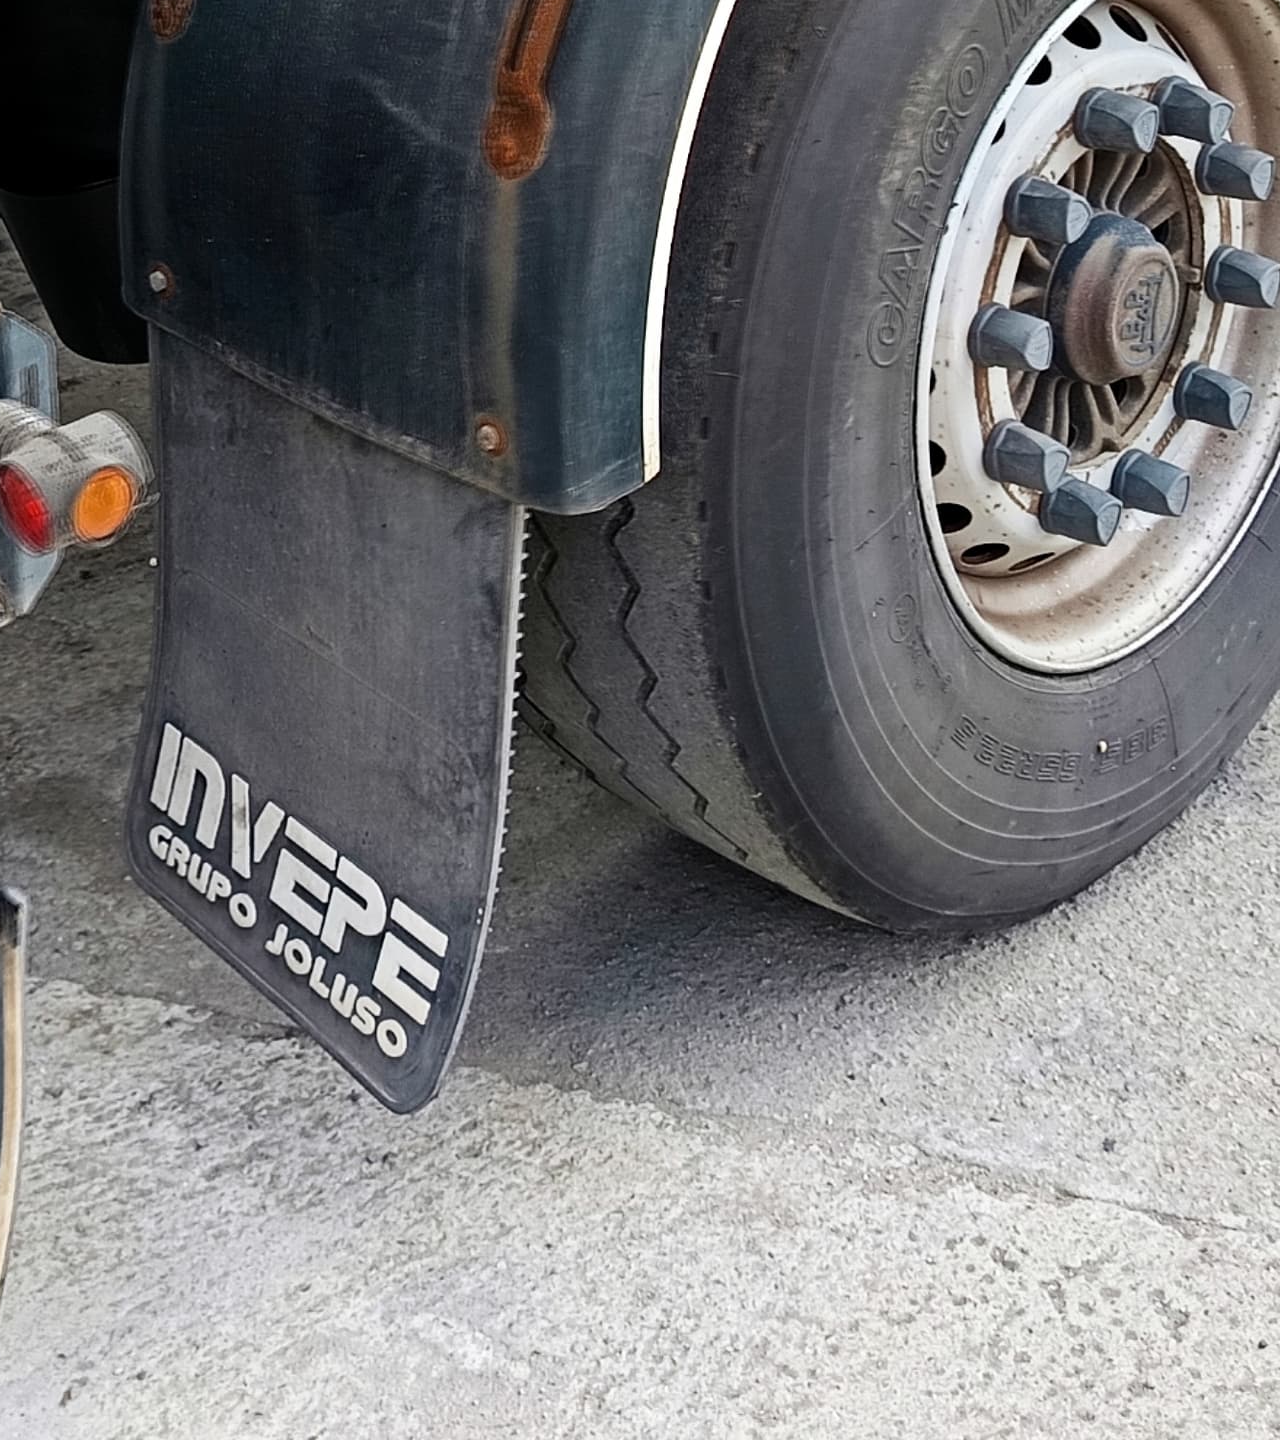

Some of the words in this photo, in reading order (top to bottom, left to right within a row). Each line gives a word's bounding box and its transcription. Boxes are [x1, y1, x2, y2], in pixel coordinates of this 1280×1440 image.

[866, 42, 989, 369] CARGO
[147, 823, 258, 930] GRUPO
[264, 922, 408, 1059] JOLUSO
[149, 721, 450, 1026] INVEPE
